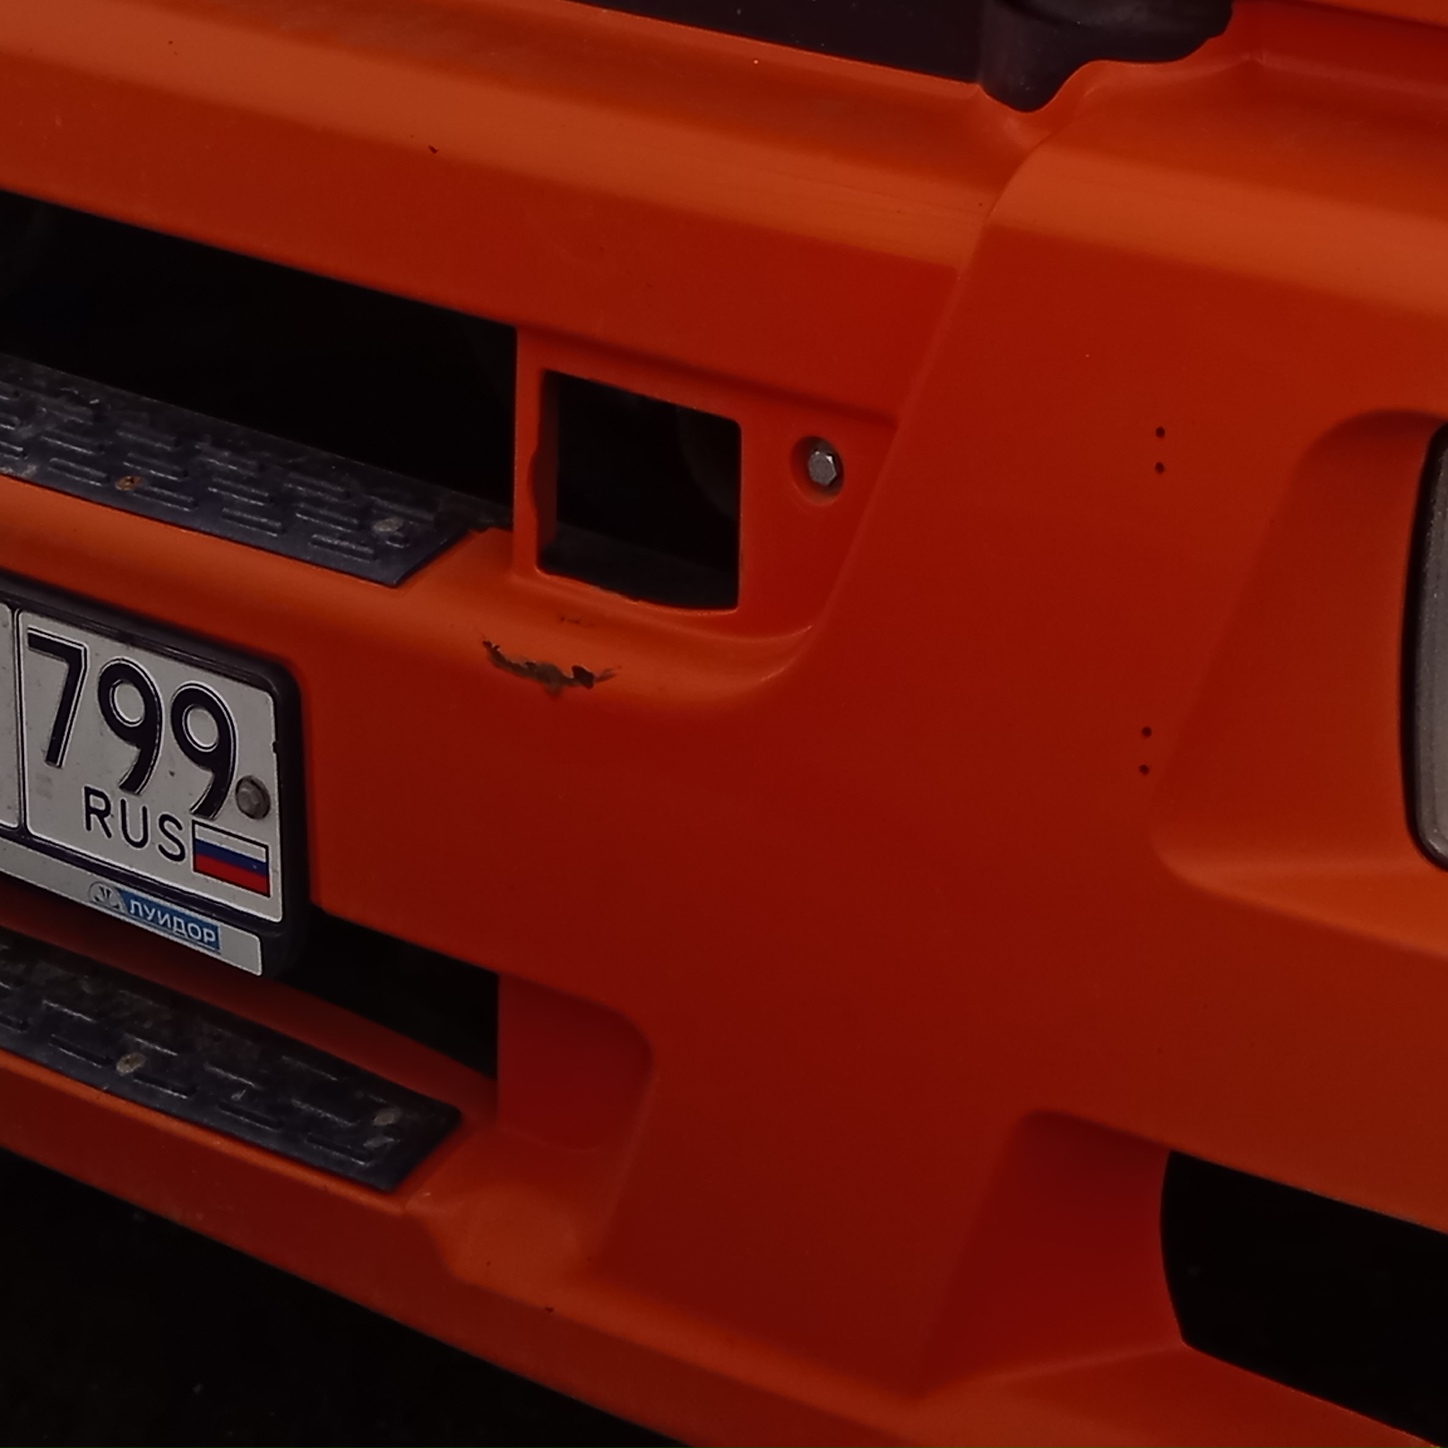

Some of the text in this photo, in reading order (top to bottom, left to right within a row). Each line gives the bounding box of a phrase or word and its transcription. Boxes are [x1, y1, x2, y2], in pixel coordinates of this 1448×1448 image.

[27, 629, 238, 818] 799
[83, 786, 186, 864] RUS
[129, 899, 216, 944] ЛУИДОР
